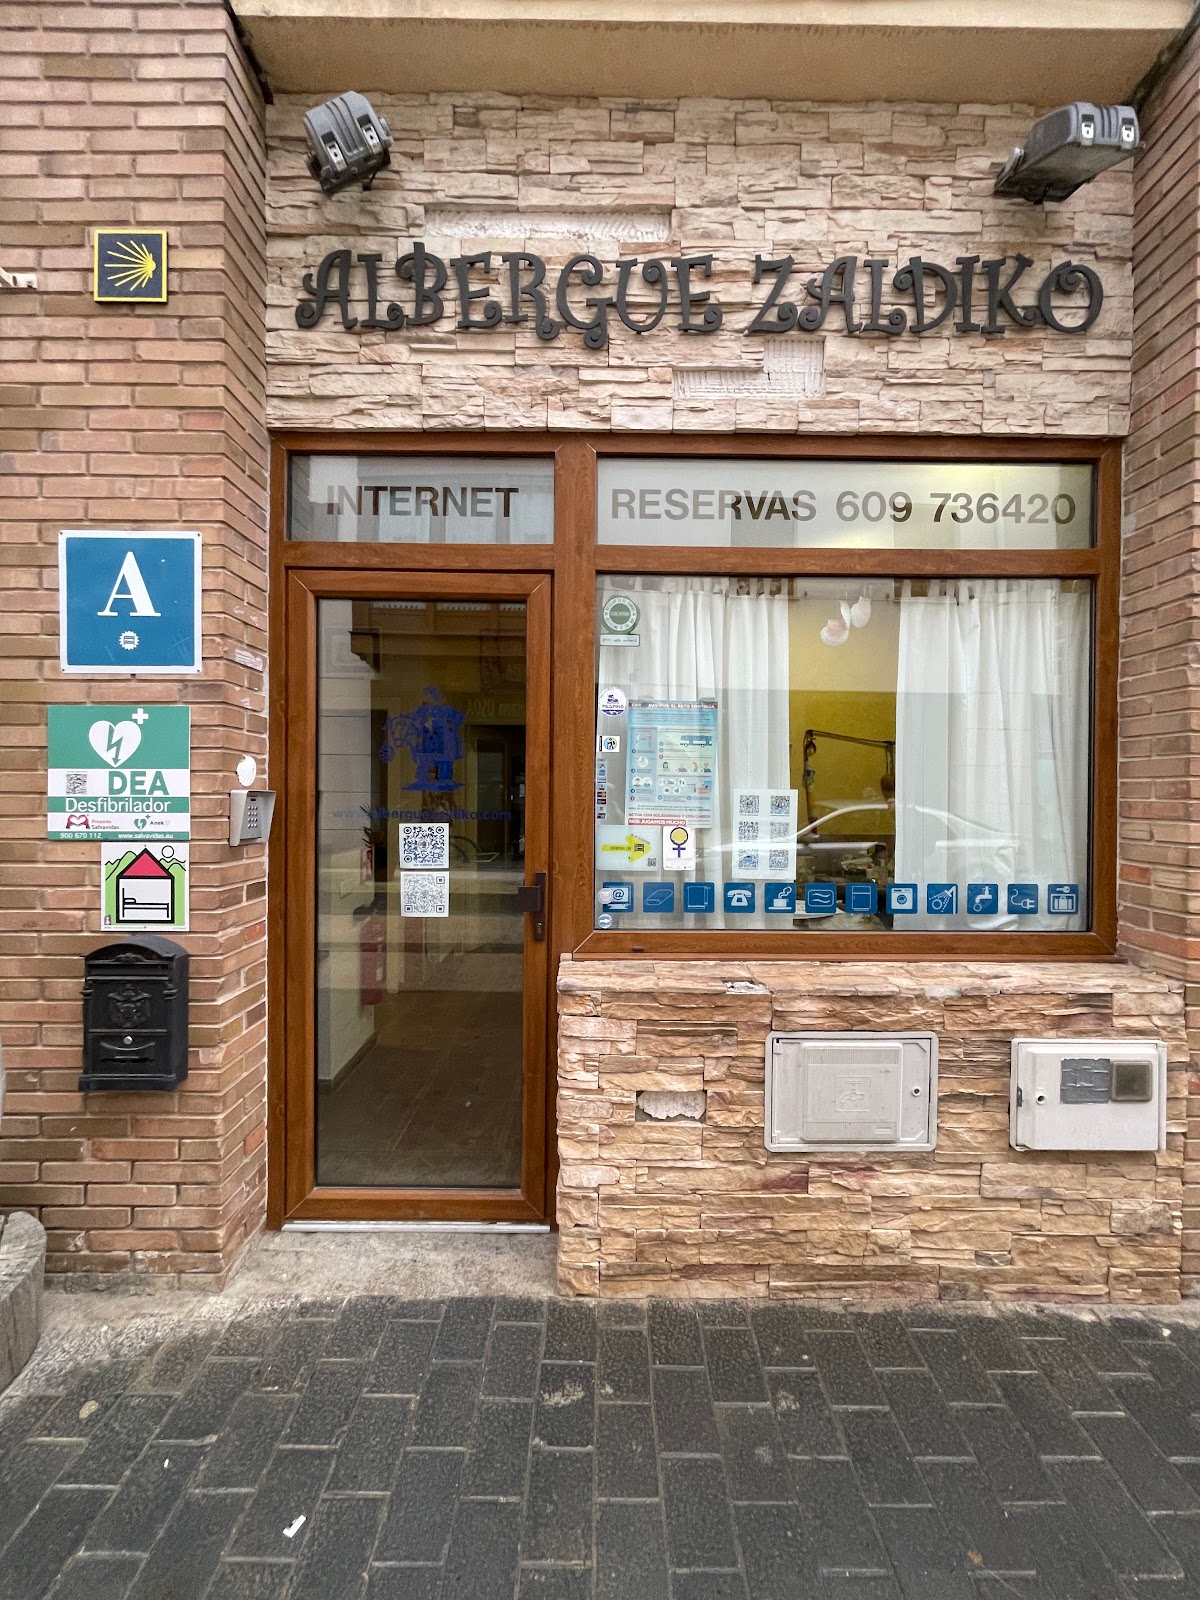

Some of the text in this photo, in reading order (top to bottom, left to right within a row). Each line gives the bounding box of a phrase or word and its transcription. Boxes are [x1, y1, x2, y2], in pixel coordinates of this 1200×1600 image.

[295, 241, 1104, 350] ALBERGUE ZALDIKO
[326, 485, 520, 518] INTERNET
[610, 488, 1077, 526] RESERVAS 609 736420
[97, 551, 161, 617] A
[108, 771, 169, 795] DEA
[65, 797, 171, 813] Desfibrilador
